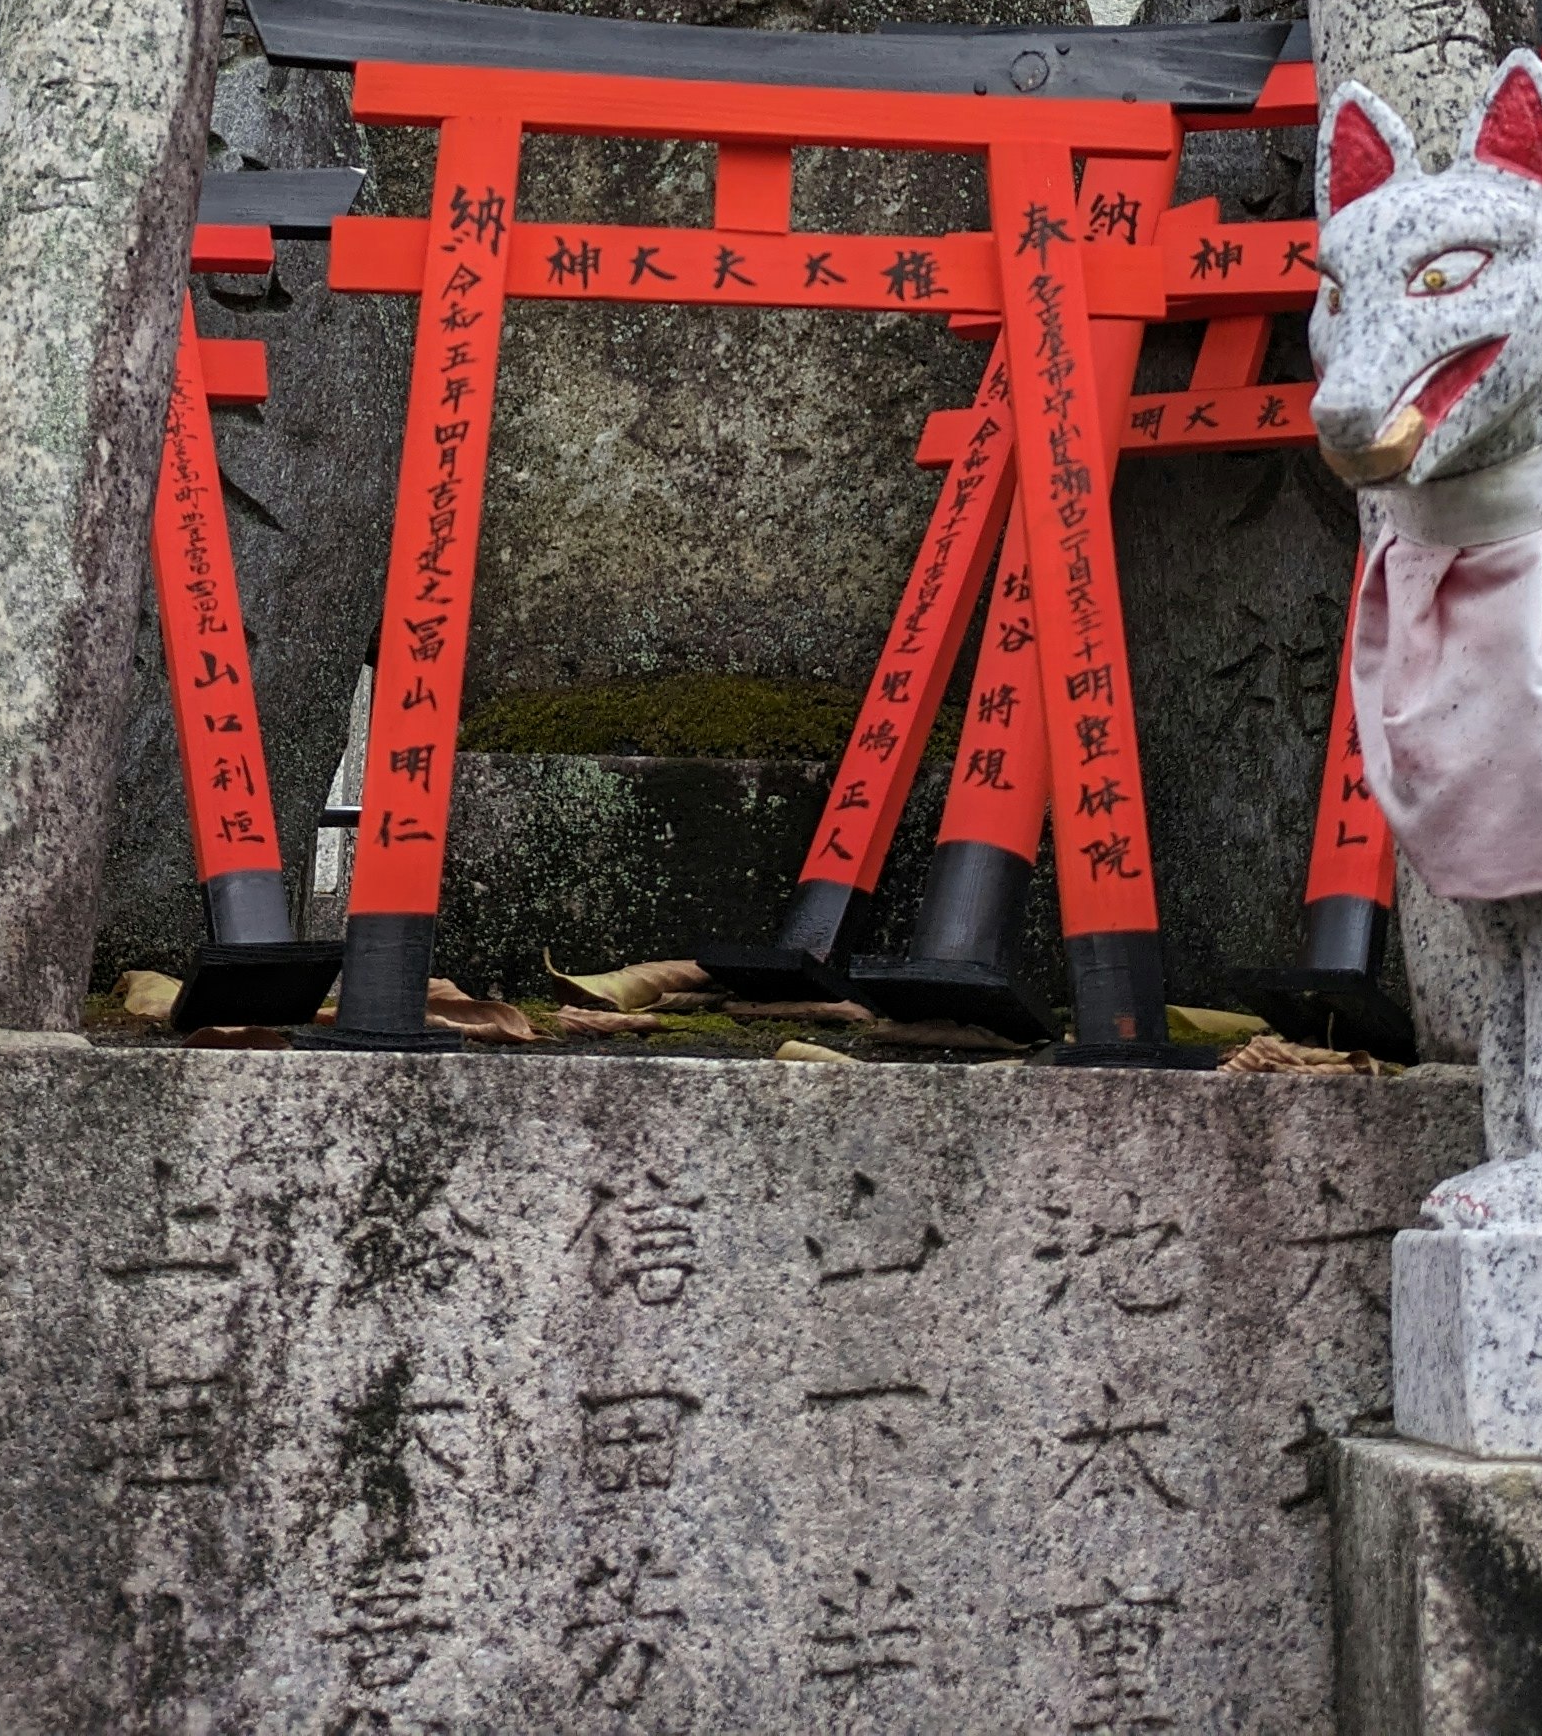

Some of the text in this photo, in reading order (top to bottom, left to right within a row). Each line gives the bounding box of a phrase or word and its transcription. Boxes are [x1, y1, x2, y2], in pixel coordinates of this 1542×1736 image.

[441, 184, 507, 257] 納
[1015, 200, 1077, 270] 奉
[1083, 191, 1142, 247] 納
